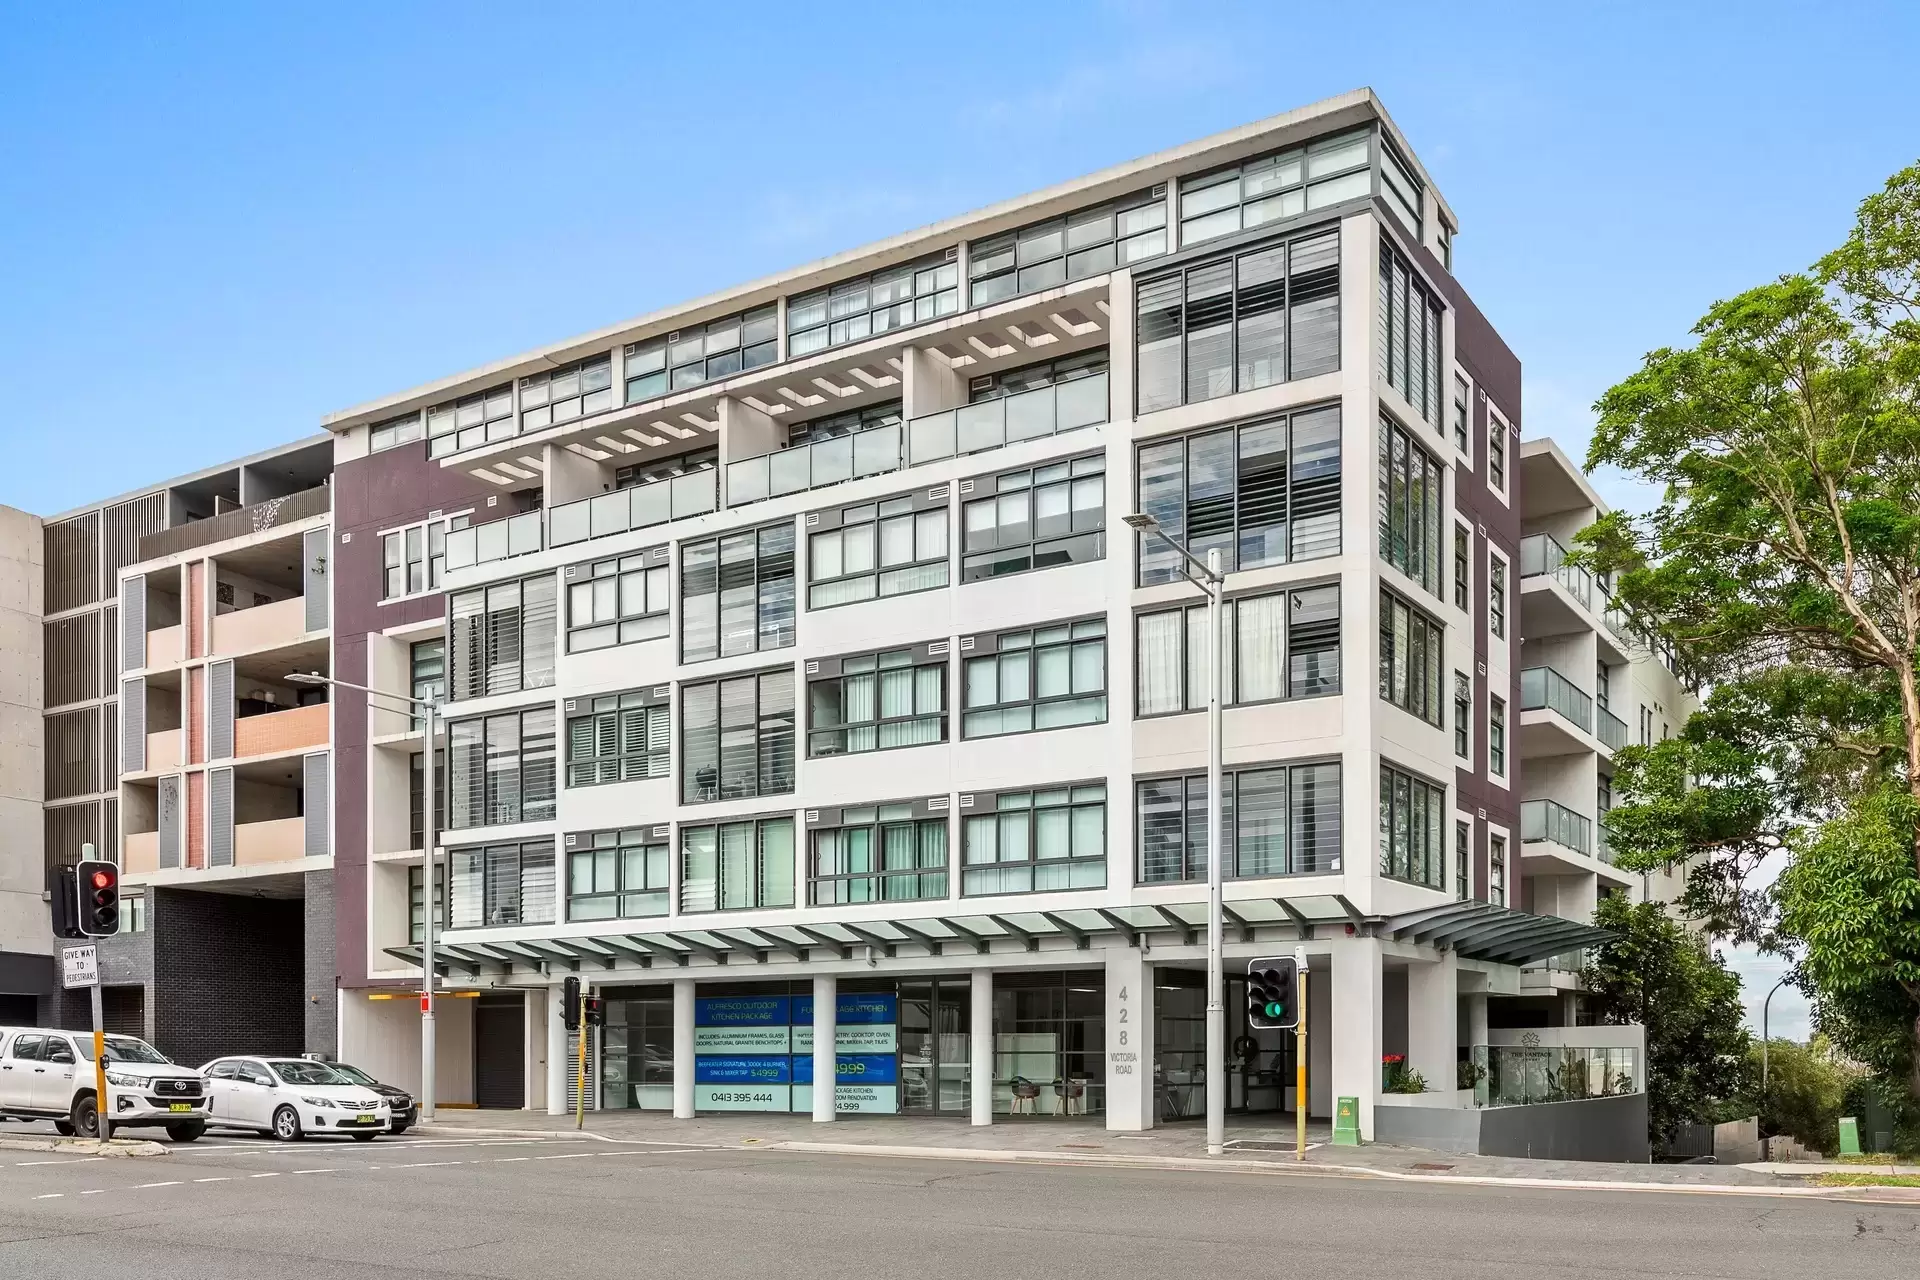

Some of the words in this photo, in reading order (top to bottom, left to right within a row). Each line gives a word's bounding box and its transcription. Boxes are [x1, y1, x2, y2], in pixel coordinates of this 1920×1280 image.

[64, 951, 79, 960] GIVE
[80, 949, 94, 957] WAY
[66, 972, 96, 983] PEDESTRIANS
[855, 1004, 888, 1012] KITCHEN
[740, 1012, 773, 1020] PACKAGE
[1110, 1052, 1137, 1063] VICTORIA
[1115, 1065, 1132, 1075] ROAD
[711, 1093, 731, 1101] 0413
[733, 1093, 751, 1103] 395
[752, 1093, 773, 1103] 444
